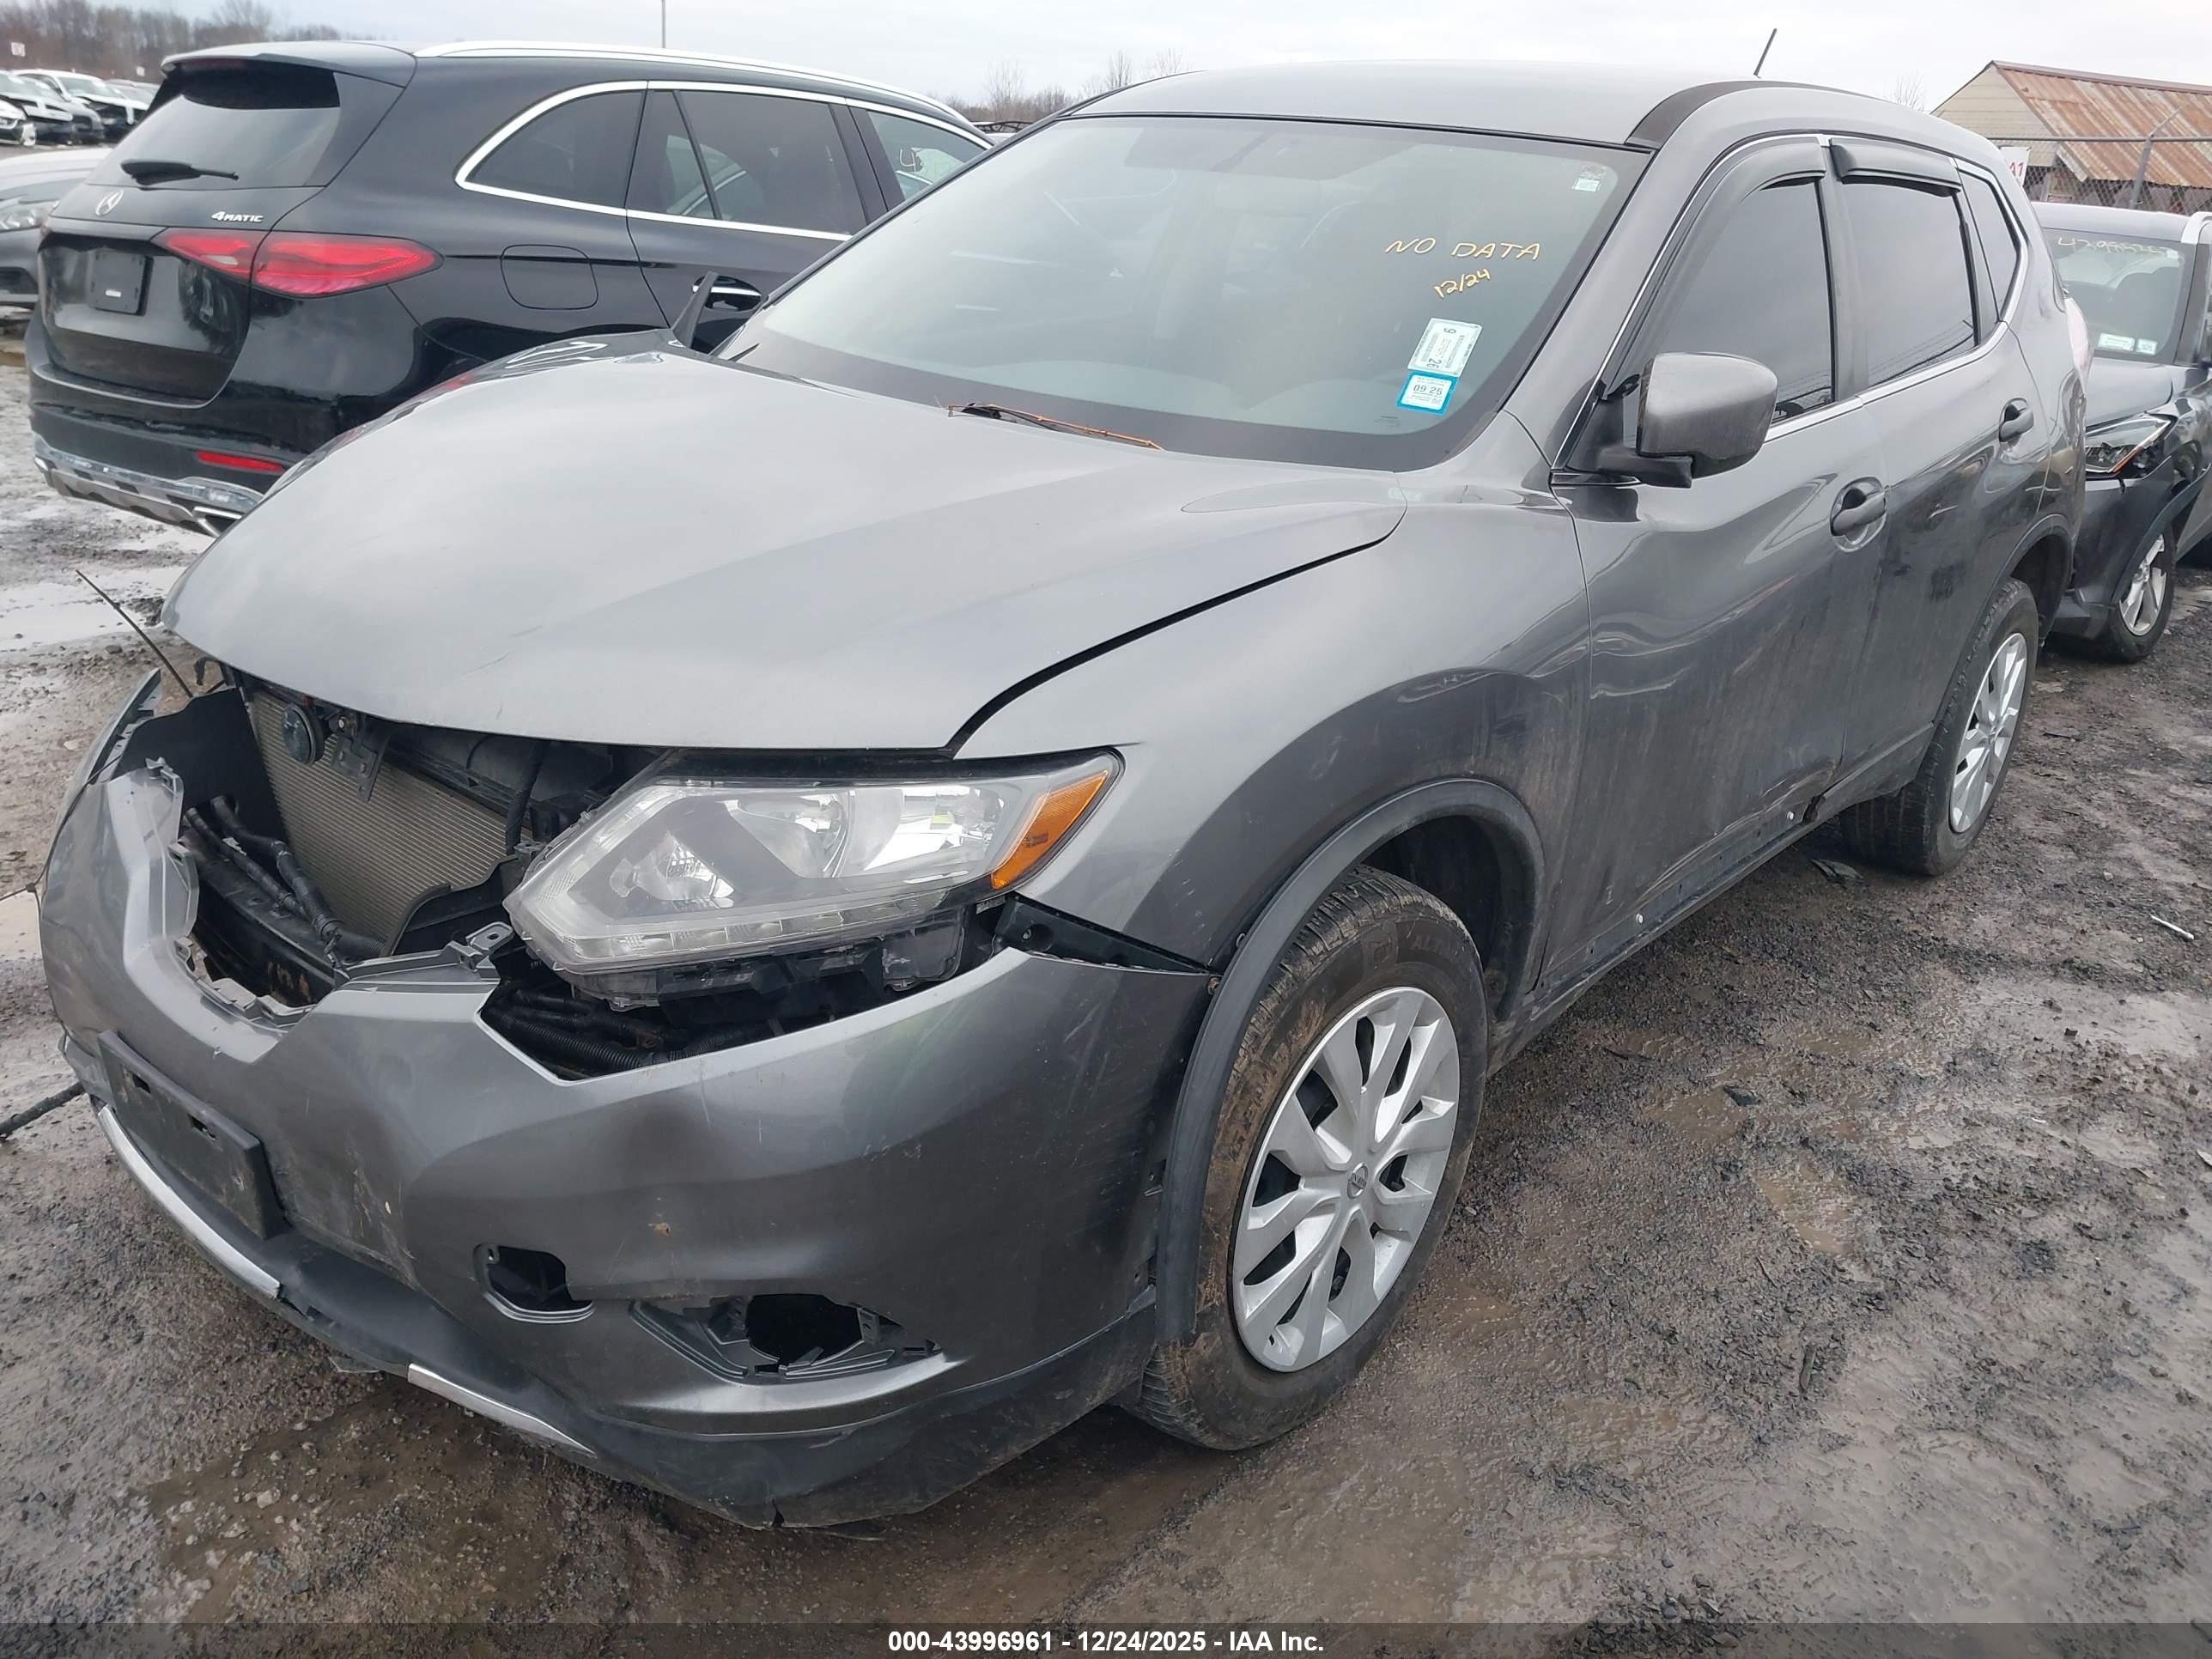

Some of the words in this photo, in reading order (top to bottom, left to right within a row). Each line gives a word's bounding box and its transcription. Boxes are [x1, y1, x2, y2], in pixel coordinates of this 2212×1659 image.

[211, 211, 264, 222] 4MATIC
[1385, 237, 1437, 254] NO
[1451, 242, 1540, 260] DATA
[1433, 268, 1492, 299] 12/24
